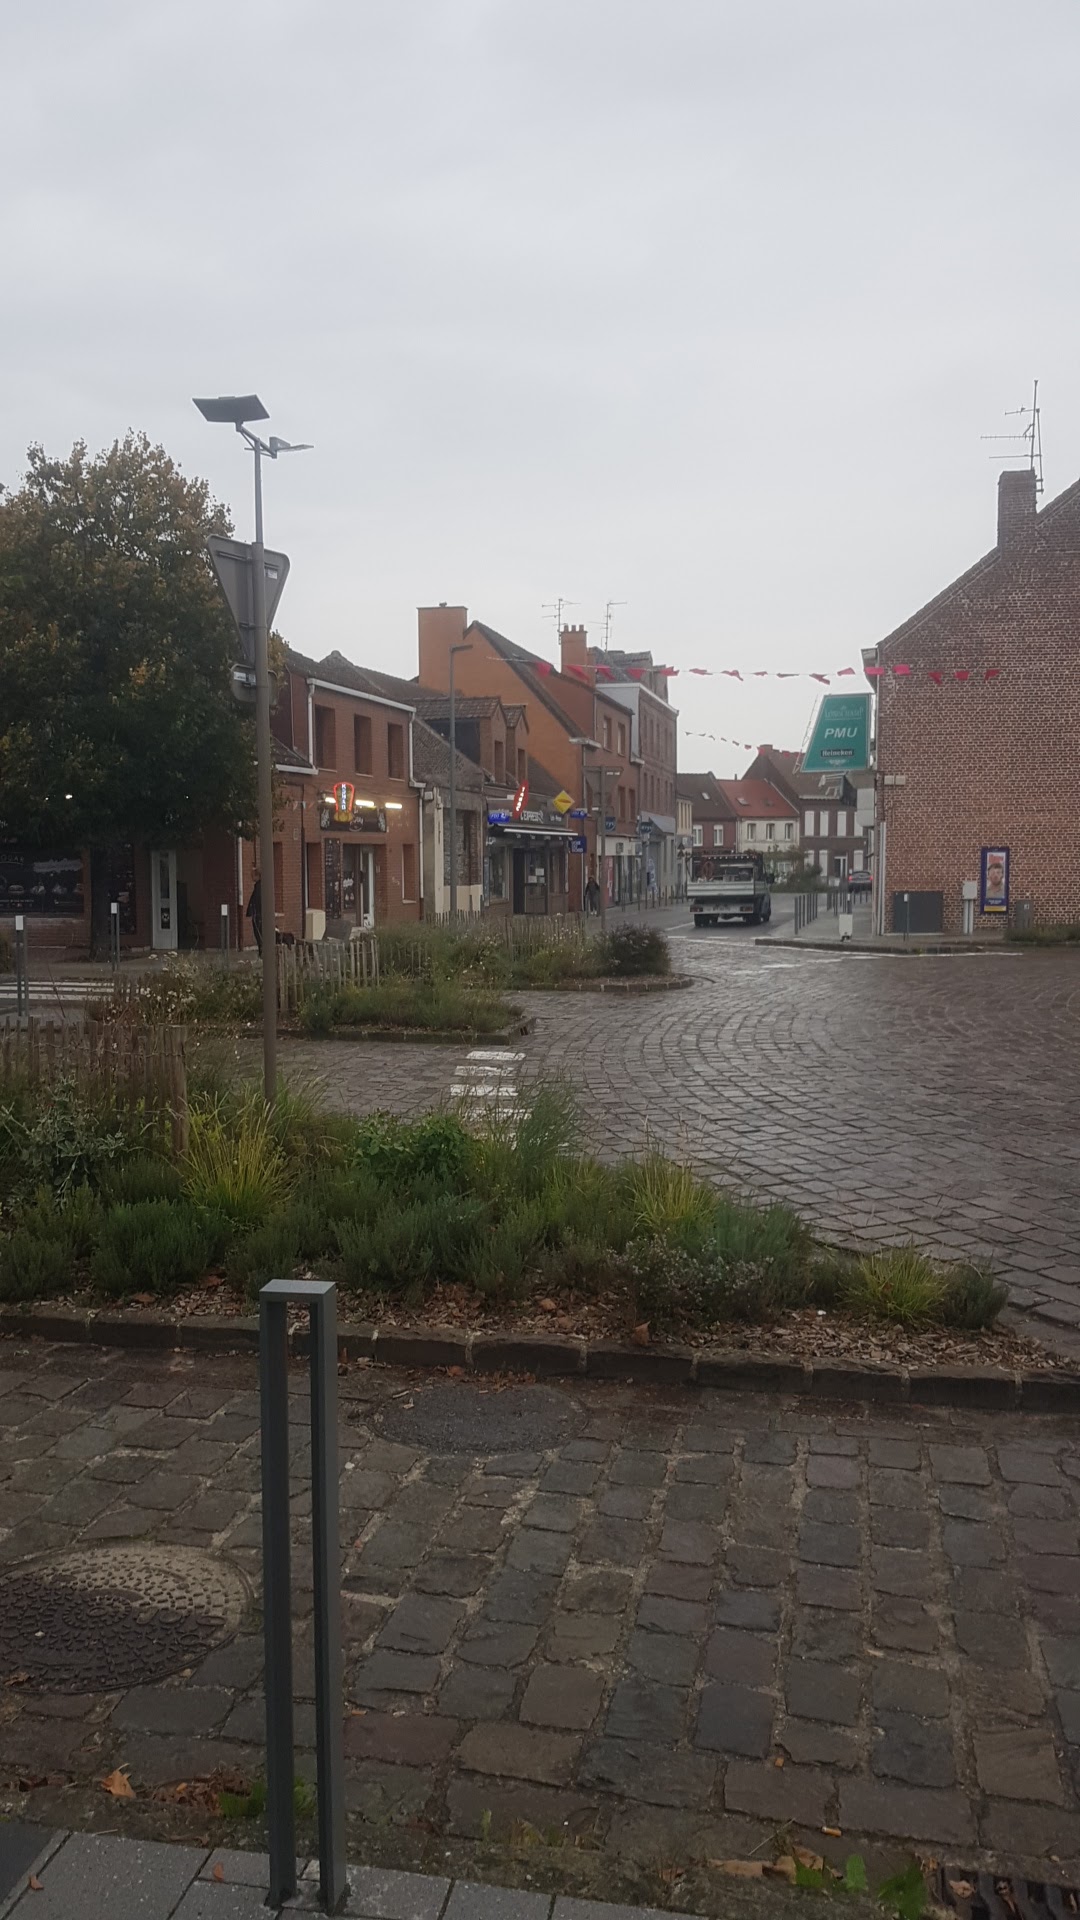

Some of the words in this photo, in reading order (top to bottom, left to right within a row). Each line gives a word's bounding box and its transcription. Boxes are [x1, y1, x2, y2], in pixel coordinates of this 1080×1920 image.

[824, 727, 858, 739] PMU
[822, 749, 853, 757] Heineken
[515, 786, 526, 812] TABAC
